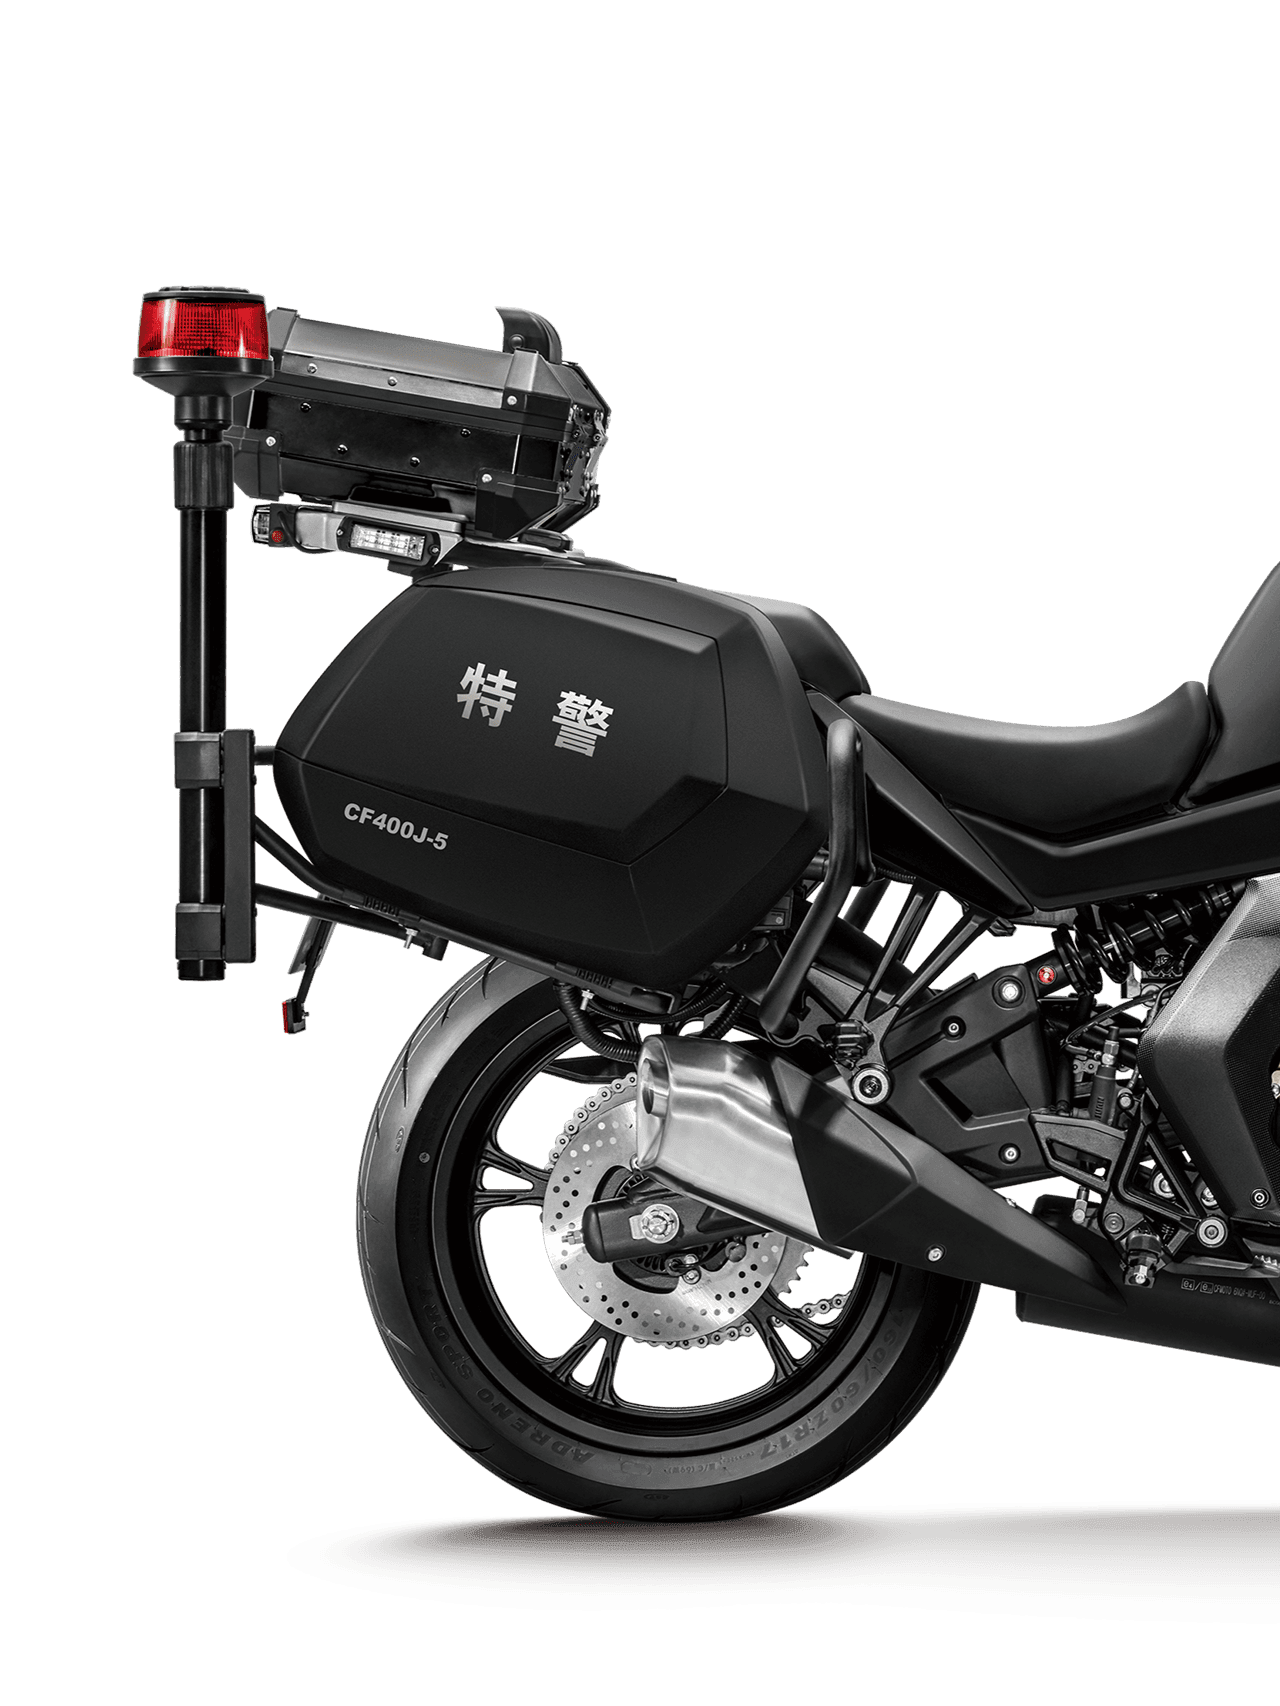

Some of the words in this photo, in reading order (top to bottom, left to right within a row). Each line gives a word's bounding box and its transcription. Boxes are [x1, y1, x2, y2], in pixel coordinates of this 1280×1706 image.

[456, 661, 616, 759] 特警
[344, 802, 448, 851] CF400J-5
[418, 1287, 474, 1380] SPORT
[477, 1387, 596, 1464] ADRENO
